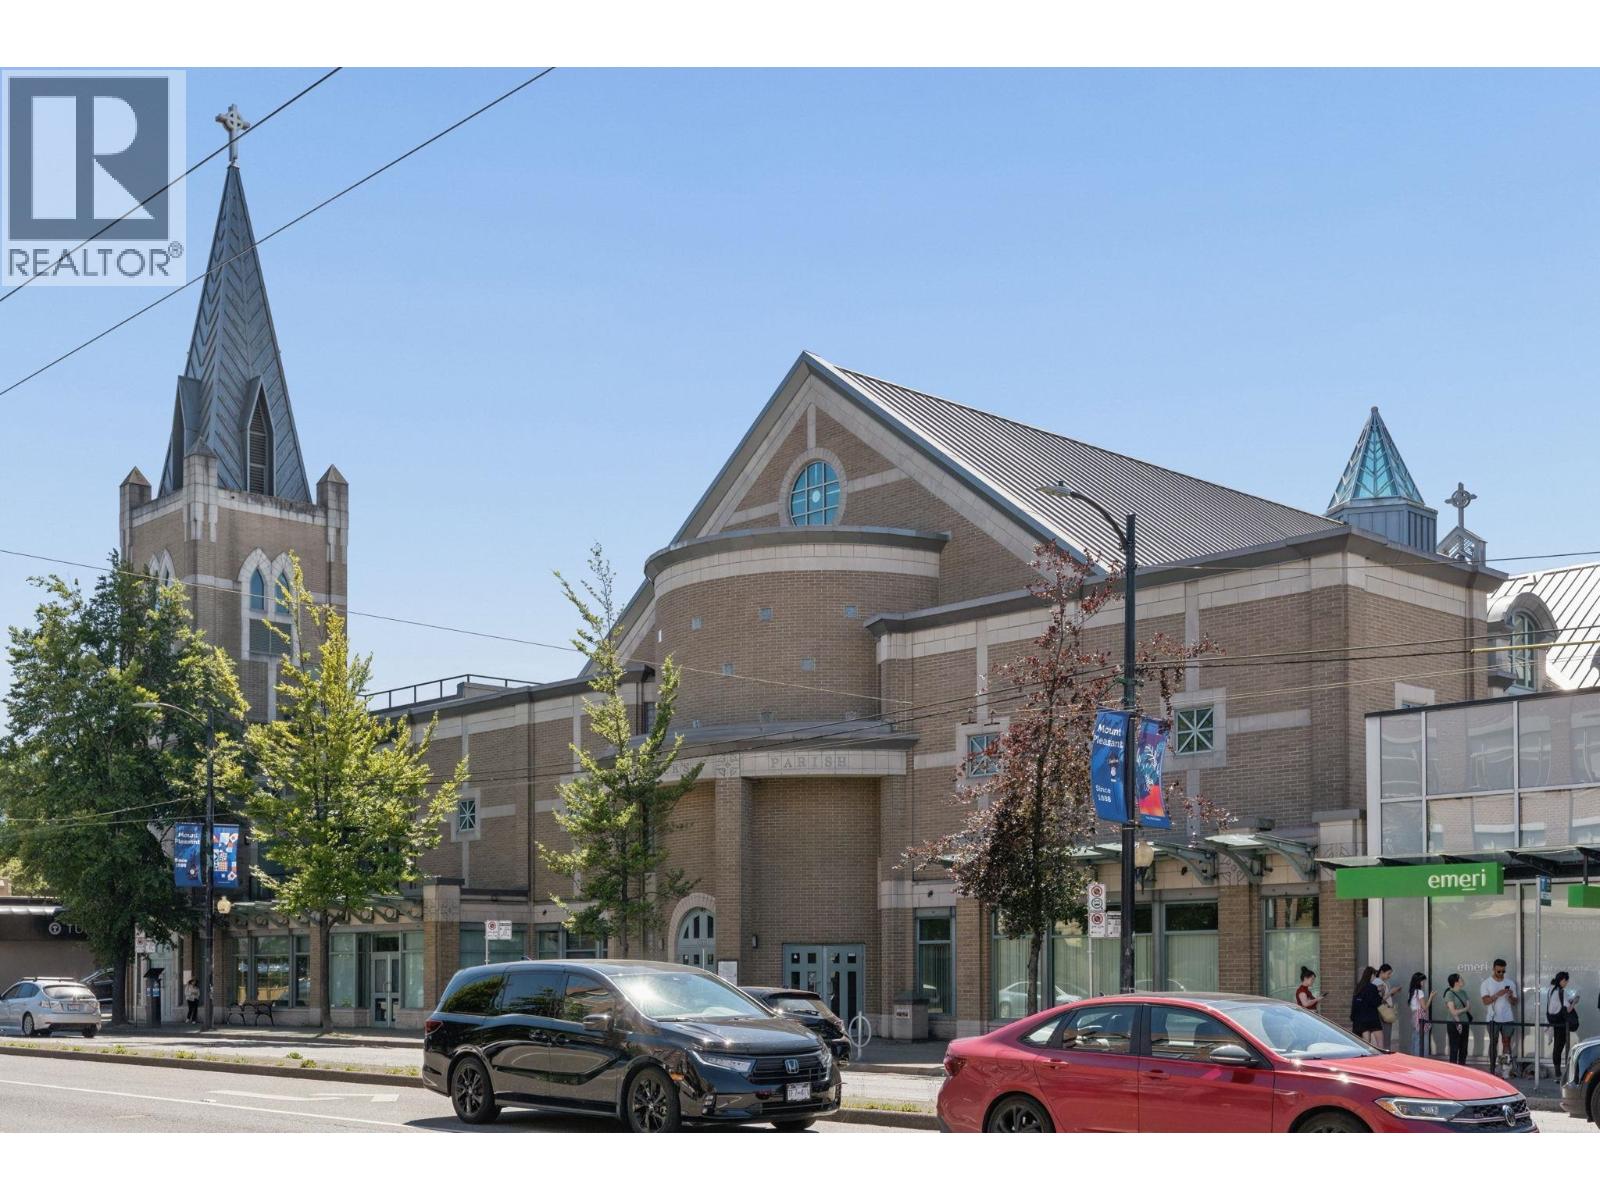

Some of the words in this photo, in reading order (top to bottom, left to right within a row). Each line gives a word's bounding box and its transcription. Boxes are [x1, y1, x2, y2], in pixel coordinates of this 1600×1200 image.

[1098, 723, 1121, 737] Mount
[1093, 734, 1124, 748] Pleasant
[770, 756, 848, 769] PARISH
[1427, 868, 1487, 891] emeri
[1457, 961, 1488, 974] emeri
